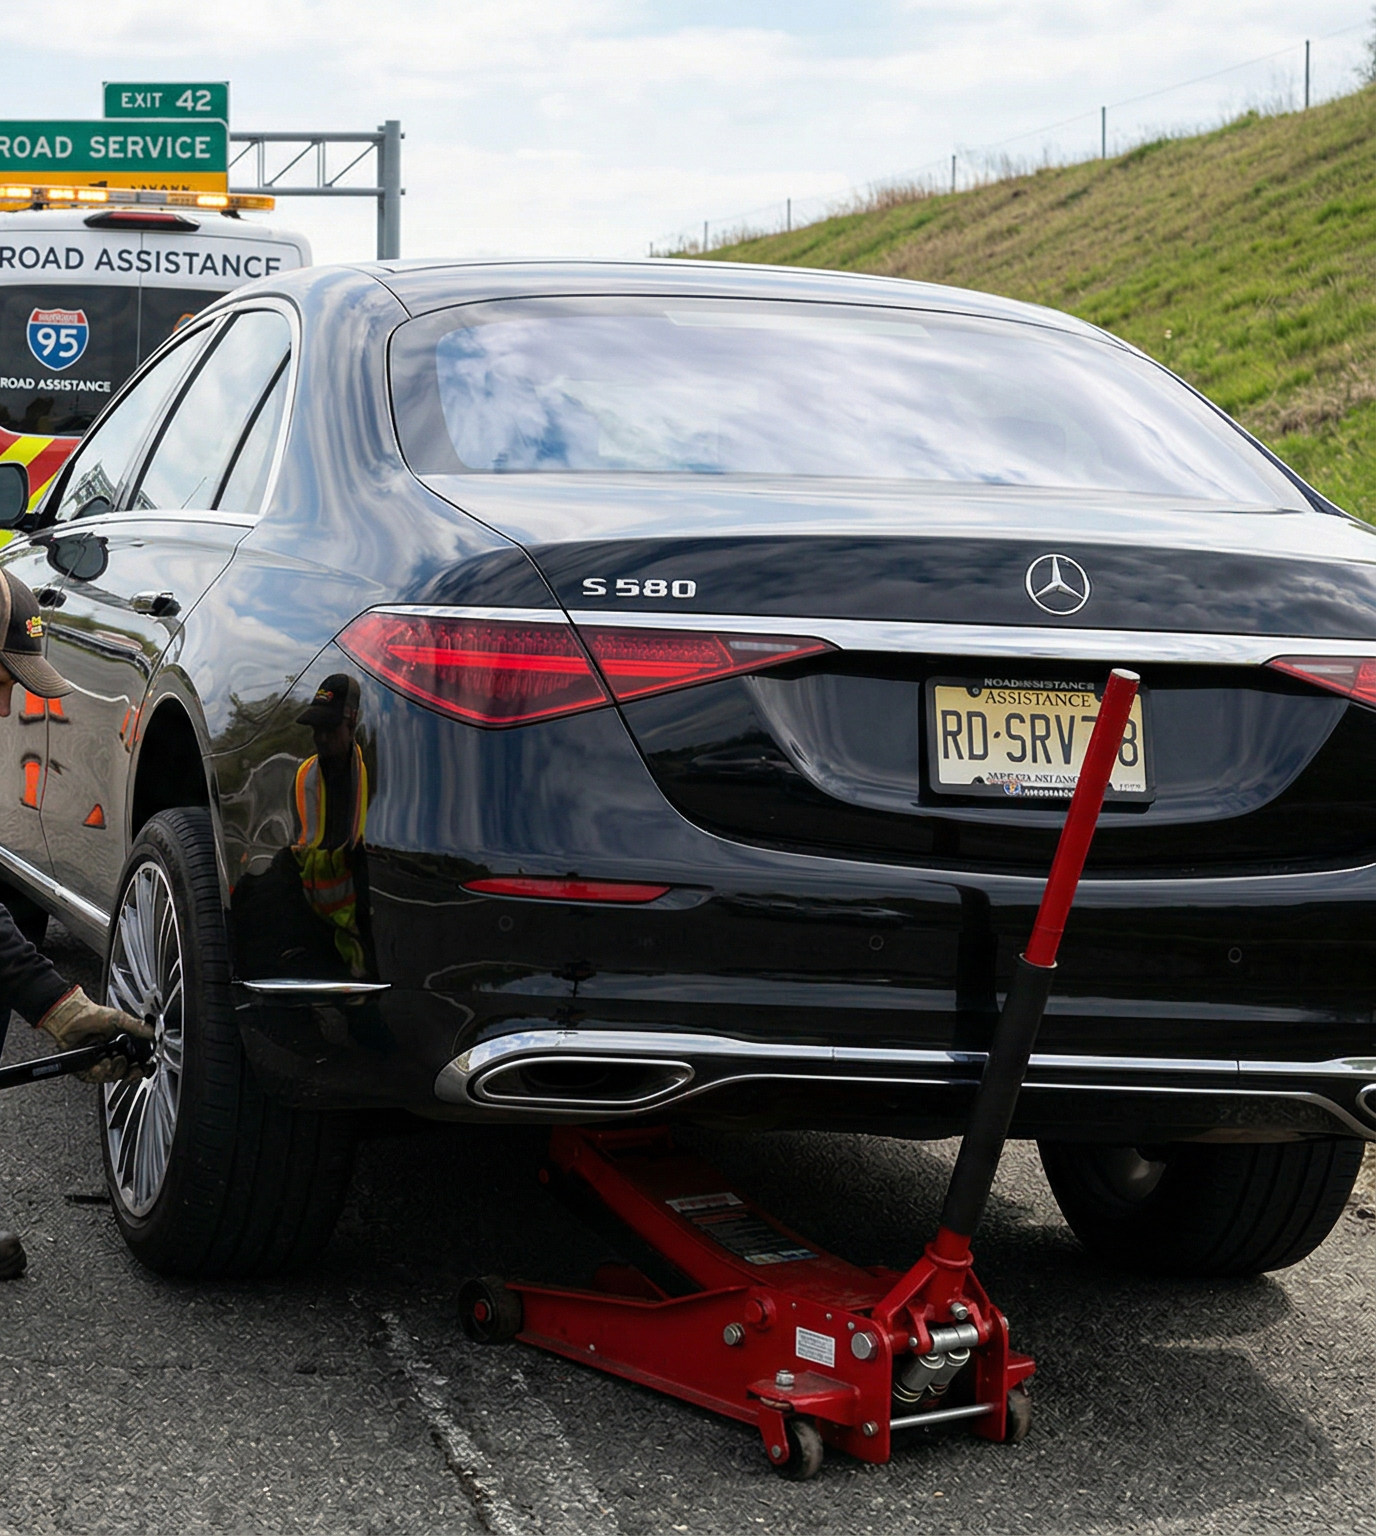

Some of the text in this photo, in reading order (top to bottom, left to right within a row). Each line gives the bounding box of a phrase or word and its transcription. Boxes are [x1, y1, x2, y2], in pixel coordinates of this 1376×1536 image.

[121, 90, 212, 112] EXIT 42
[89, 136, 211, 159] SERVICE
[94, 249, 281, 278] ASSISTANCE
[36, 327, 79, 357] 95
[0, 377, 111, 393] ROAD ASSISTANCE
[582, 578, 697, 598] S 580
[985, 690, 1092, 708] ASSISTANCE
